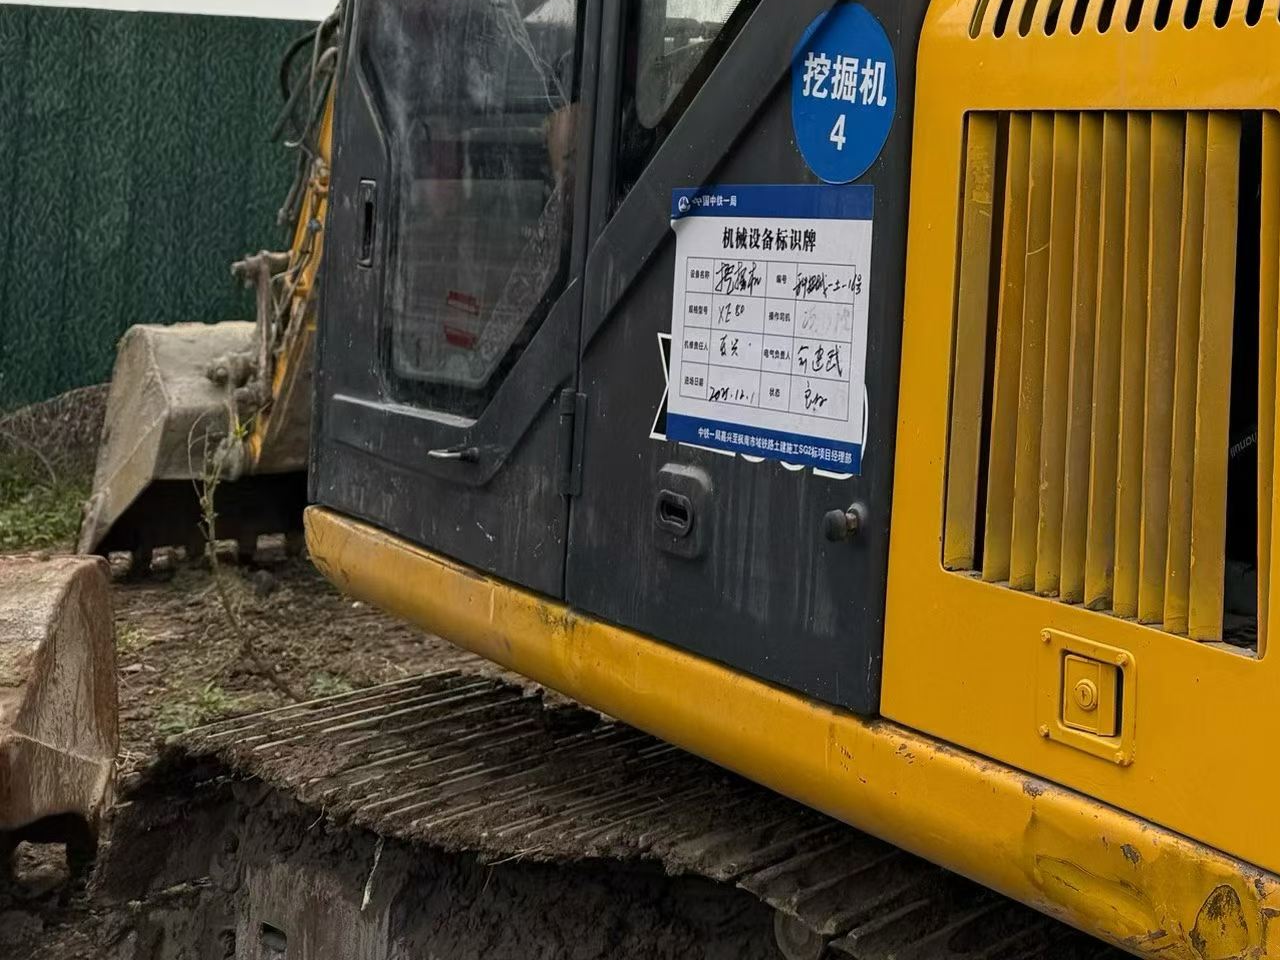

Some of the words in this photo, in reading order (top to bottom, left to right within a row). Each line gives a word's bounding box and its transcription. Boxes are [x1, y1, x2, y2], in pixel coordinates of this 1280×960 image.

[802, 52, 888, 107] 挖掘机
[829, 113, 847, 151] 4
[722, 226, 817, 252] 机械设备标识牌
[776, 274, 788, 285] 编号
